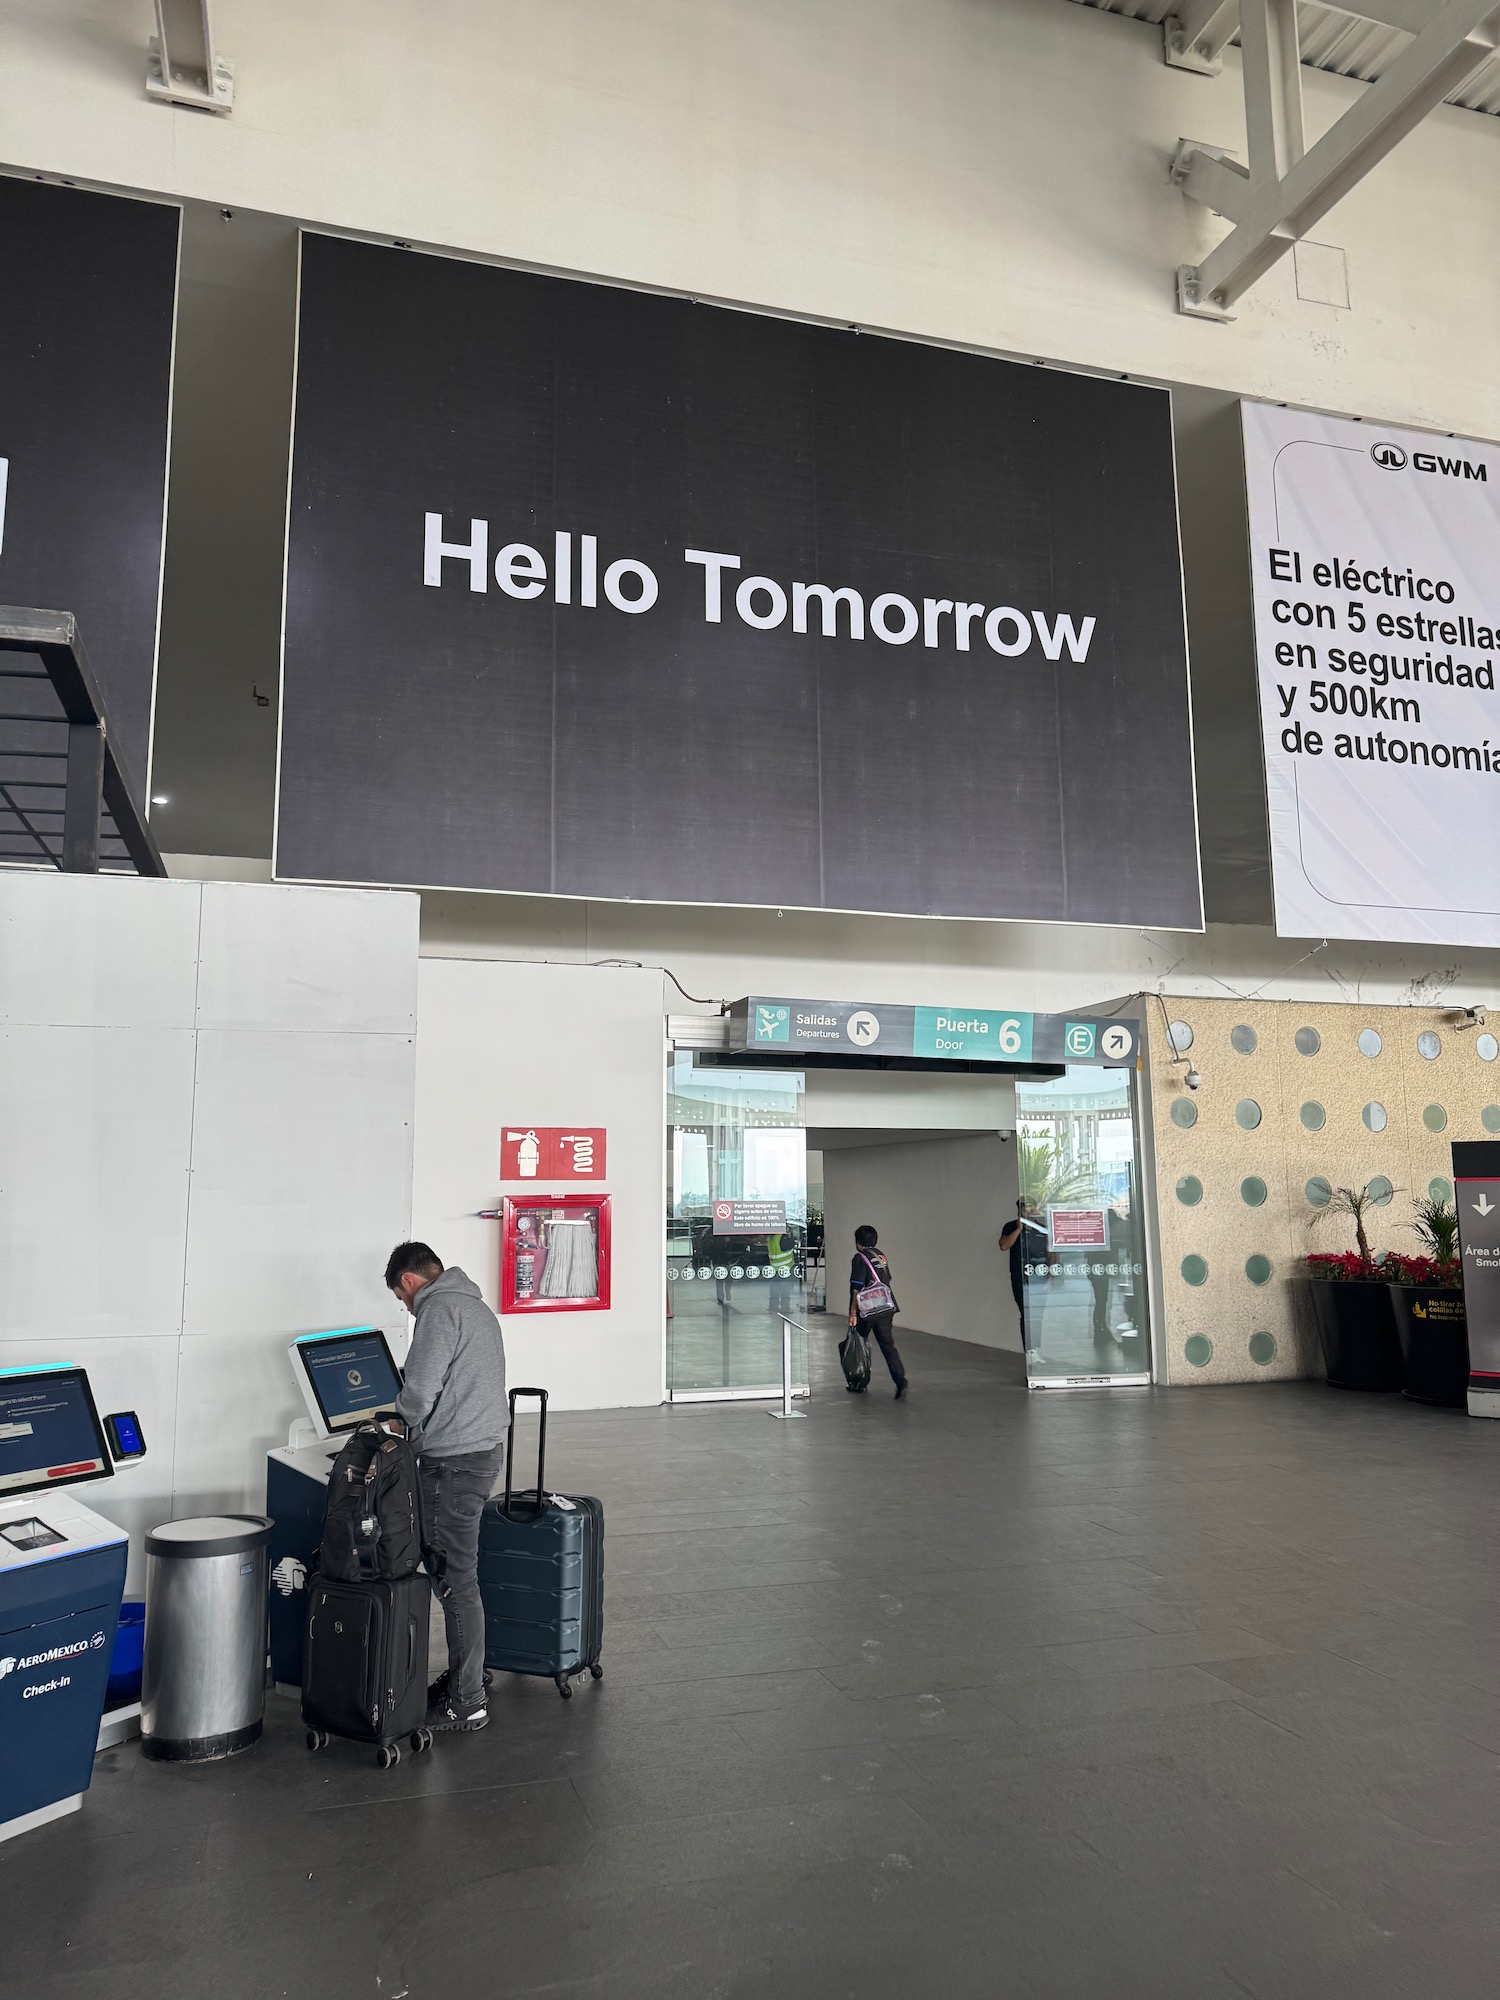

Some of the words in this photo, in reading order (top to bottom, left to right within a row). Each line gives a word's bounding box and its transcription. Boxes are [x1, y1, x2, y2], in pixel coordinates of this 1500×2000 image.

[1413, 452, 1488, 482] GWM
[423, 511, 659, 614] Hello
[685, 548, 1097, 664] Tomorrow
[1269, 548, 1302, 583] El
[1313, 557, 1455, 604] eléctrico
[1272, 599, 1336, 630] con
[1347, 601, 1366, 633] 5
[1275, 641, 1317, 669] en
[1328, 647, 1495, 690] seguridad
[1277, 683, 1297, 717] y
[1309, 680, 1421, 723] 500km
[1281, 721, 1323, 755] de
[796, 1014, 837, 1026] Salidas
[796, 1029, 840, 1039] Departures
[935, 1038, 963, 1050] Door
[936, 1017, 989, 1034] Puerta
[999, 1018, 1021, 1054] 6
[1465, 1244, 1490, 1256] Área
[1440, 1300, 1455, 1308] tirar
[17, 1640, 88, 1670] AEROMEXICO
[22, 1676, 71, 1699] Check-in
